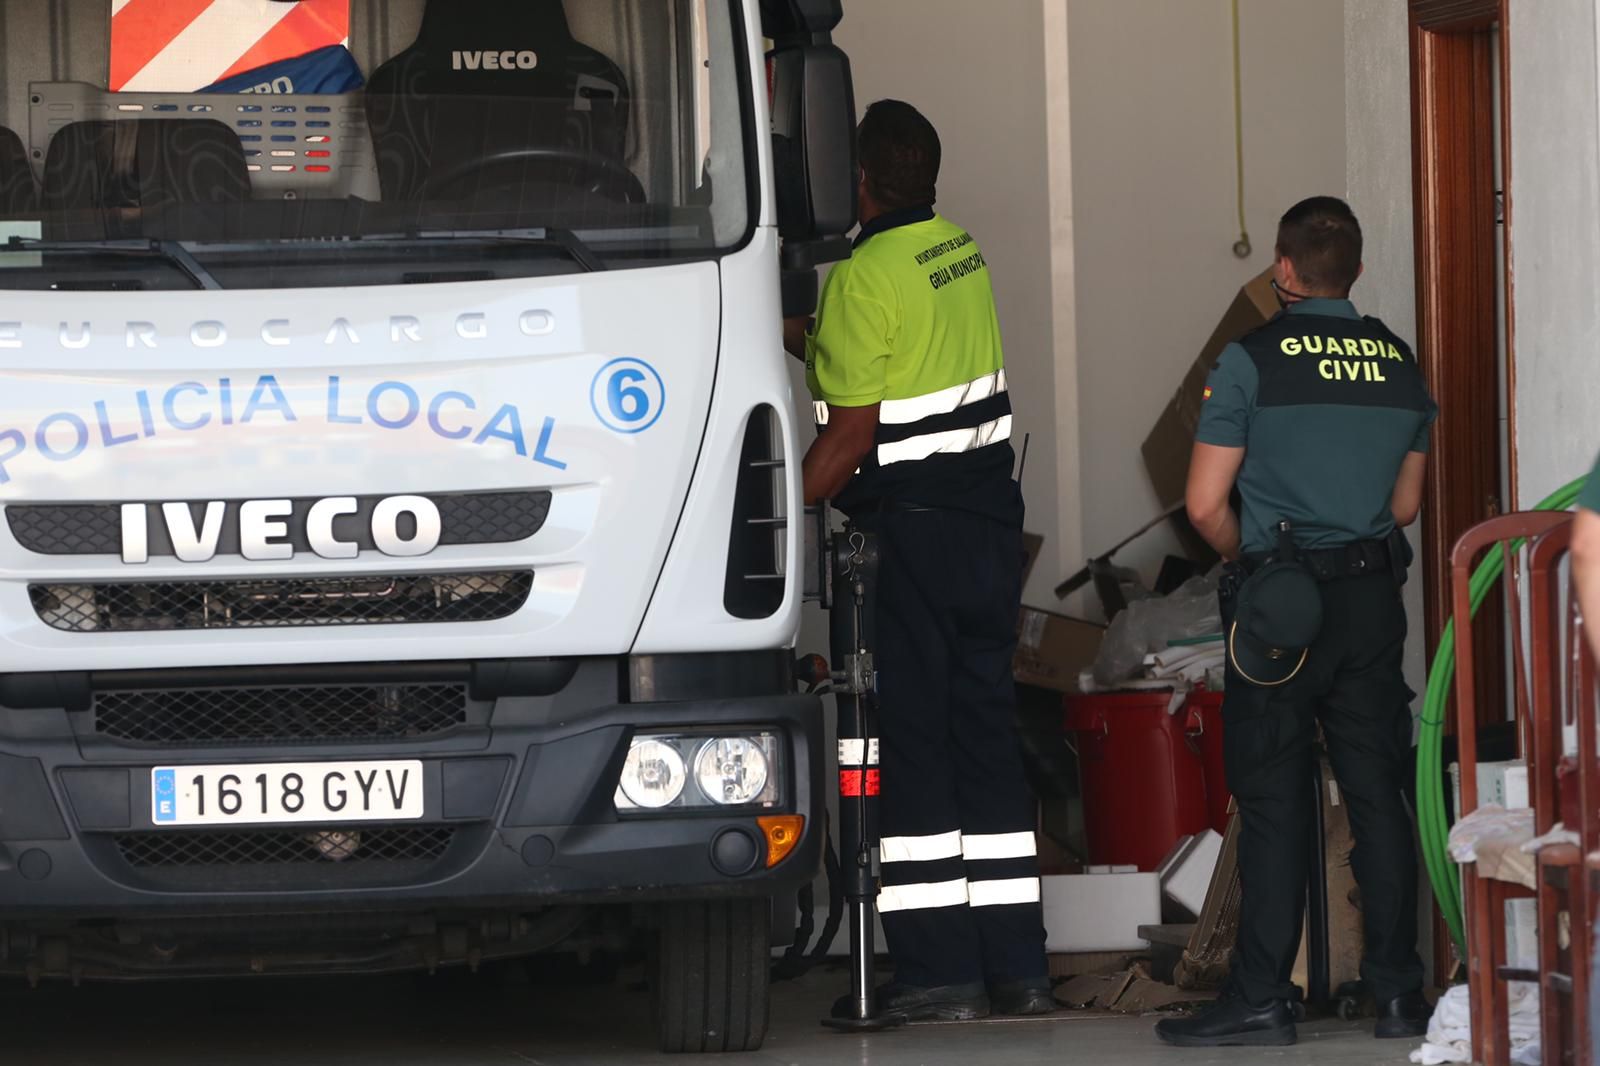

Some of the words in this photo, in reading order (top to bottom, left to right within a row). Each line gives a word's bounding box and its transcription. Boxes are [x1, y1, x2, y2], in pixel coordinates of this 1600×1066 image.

[452, 50, 538, 70] IVECO
[929, 266, 953, 290] GRÚA
[949, 251, 987, 281] MUNICIPA
[0, 309, 556, 349] EUROCARGO
[1280, 335, 1403, 362] GUARDIA
[1318, 359, 1386, 381] CIVIL
[607, 368, 649, 422] 6
[0, 375, 298, 484] POLICIA
[327, 375, 567, 470] LOCAL
[121, 494, 442, 564] IVECO
[160, 800, 171, 814] E
[192, 772, 304, 816] 1618
[322, 768, 409, 812] GYV
